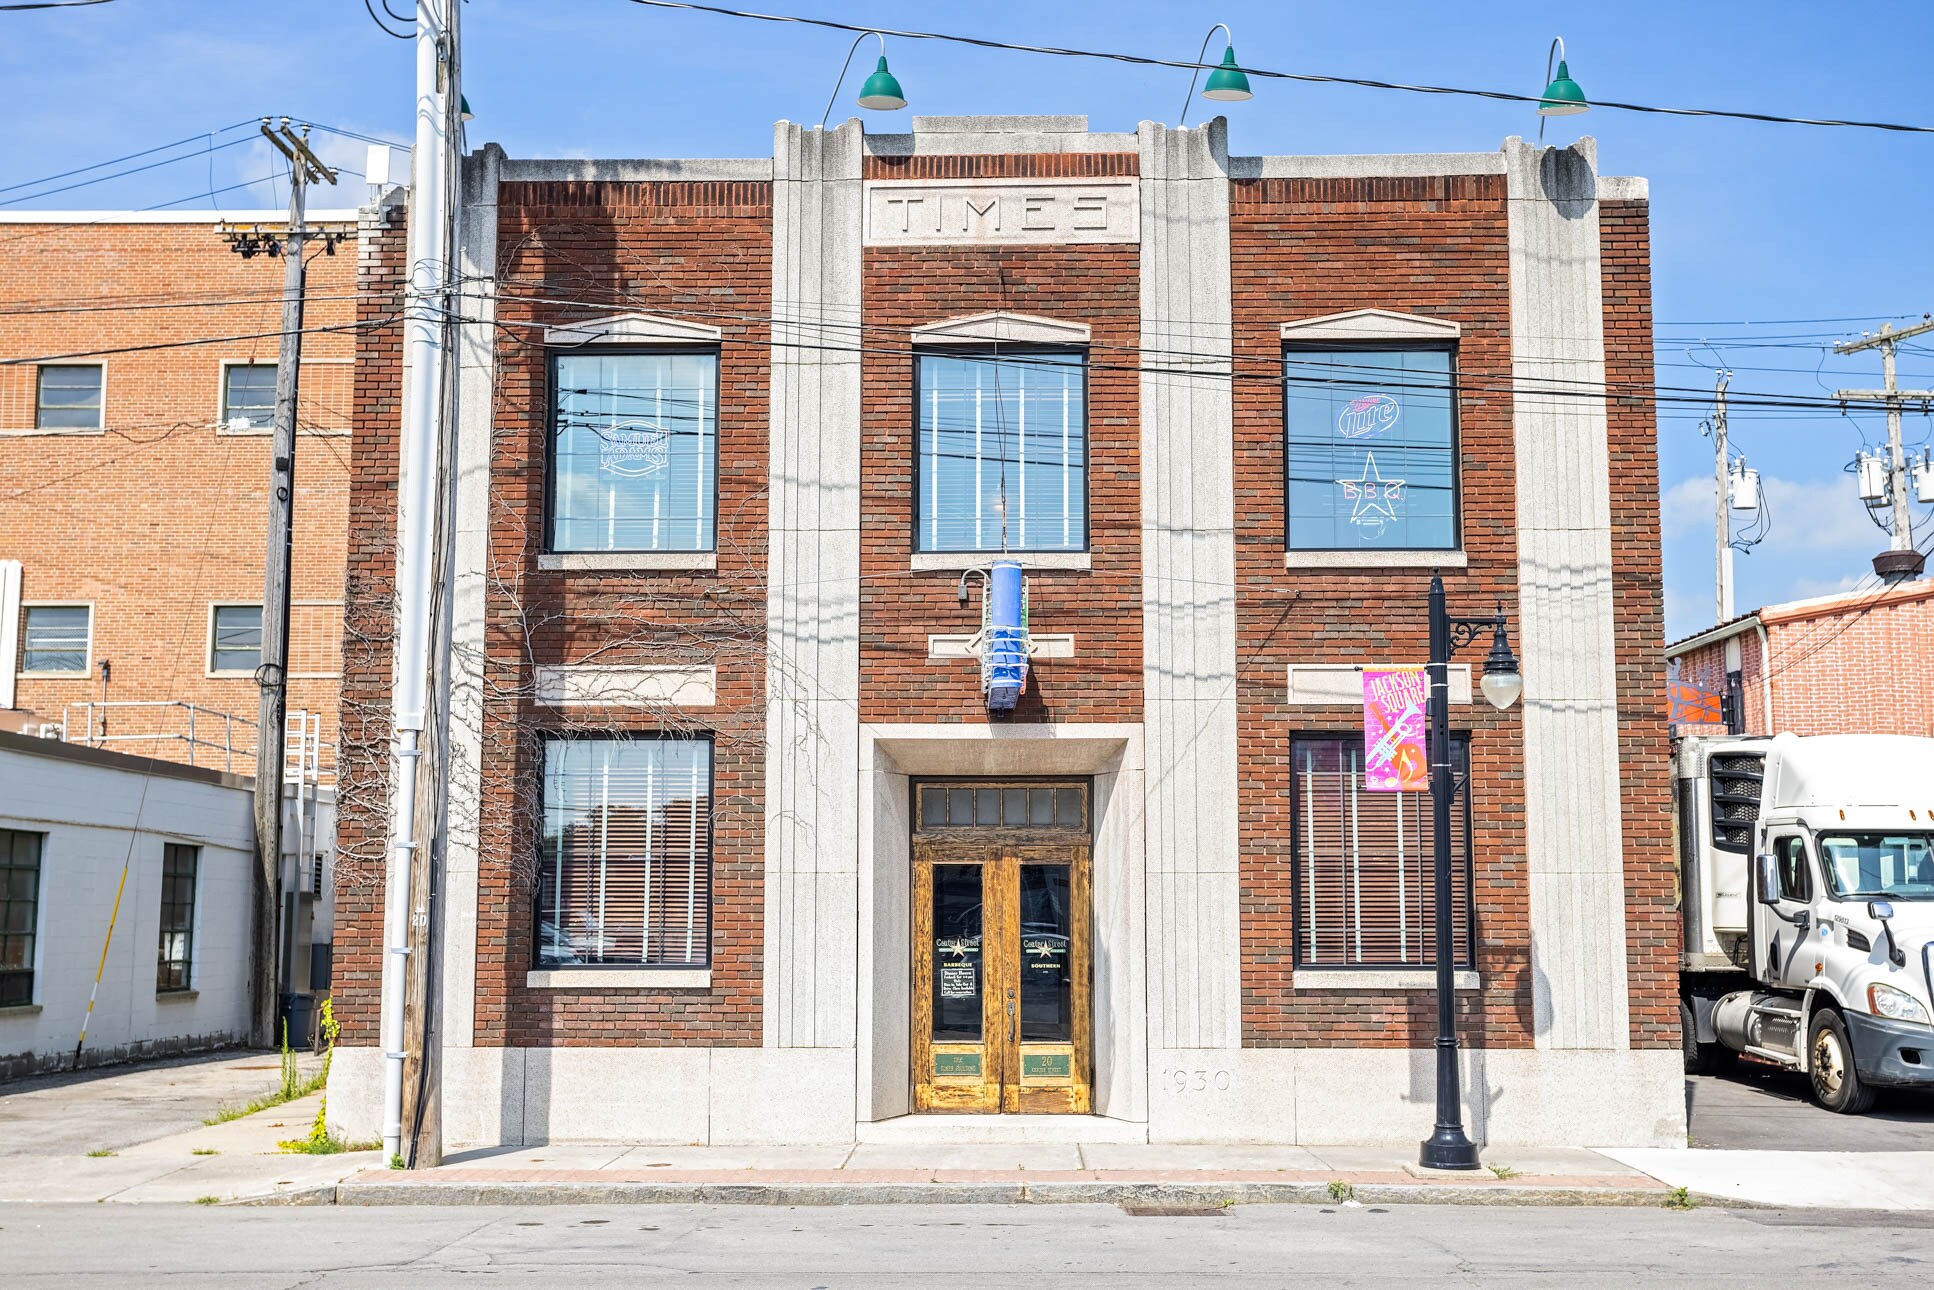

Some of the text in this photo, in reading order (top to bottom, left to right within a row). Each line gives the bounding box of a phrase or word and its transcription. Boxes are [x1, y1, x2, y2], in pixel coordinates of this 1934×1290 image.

[887, 194, 1108, 233] TIMES
[1343, 481, 1400, 500] BBQ
[1370, 672, 1421, 701] JACKSON
[1381, 685, 1426, 713] SQUARE
[1041, 1055, 1053, 1067] 20
[1163, 1069, 1231, 1094] 1930
